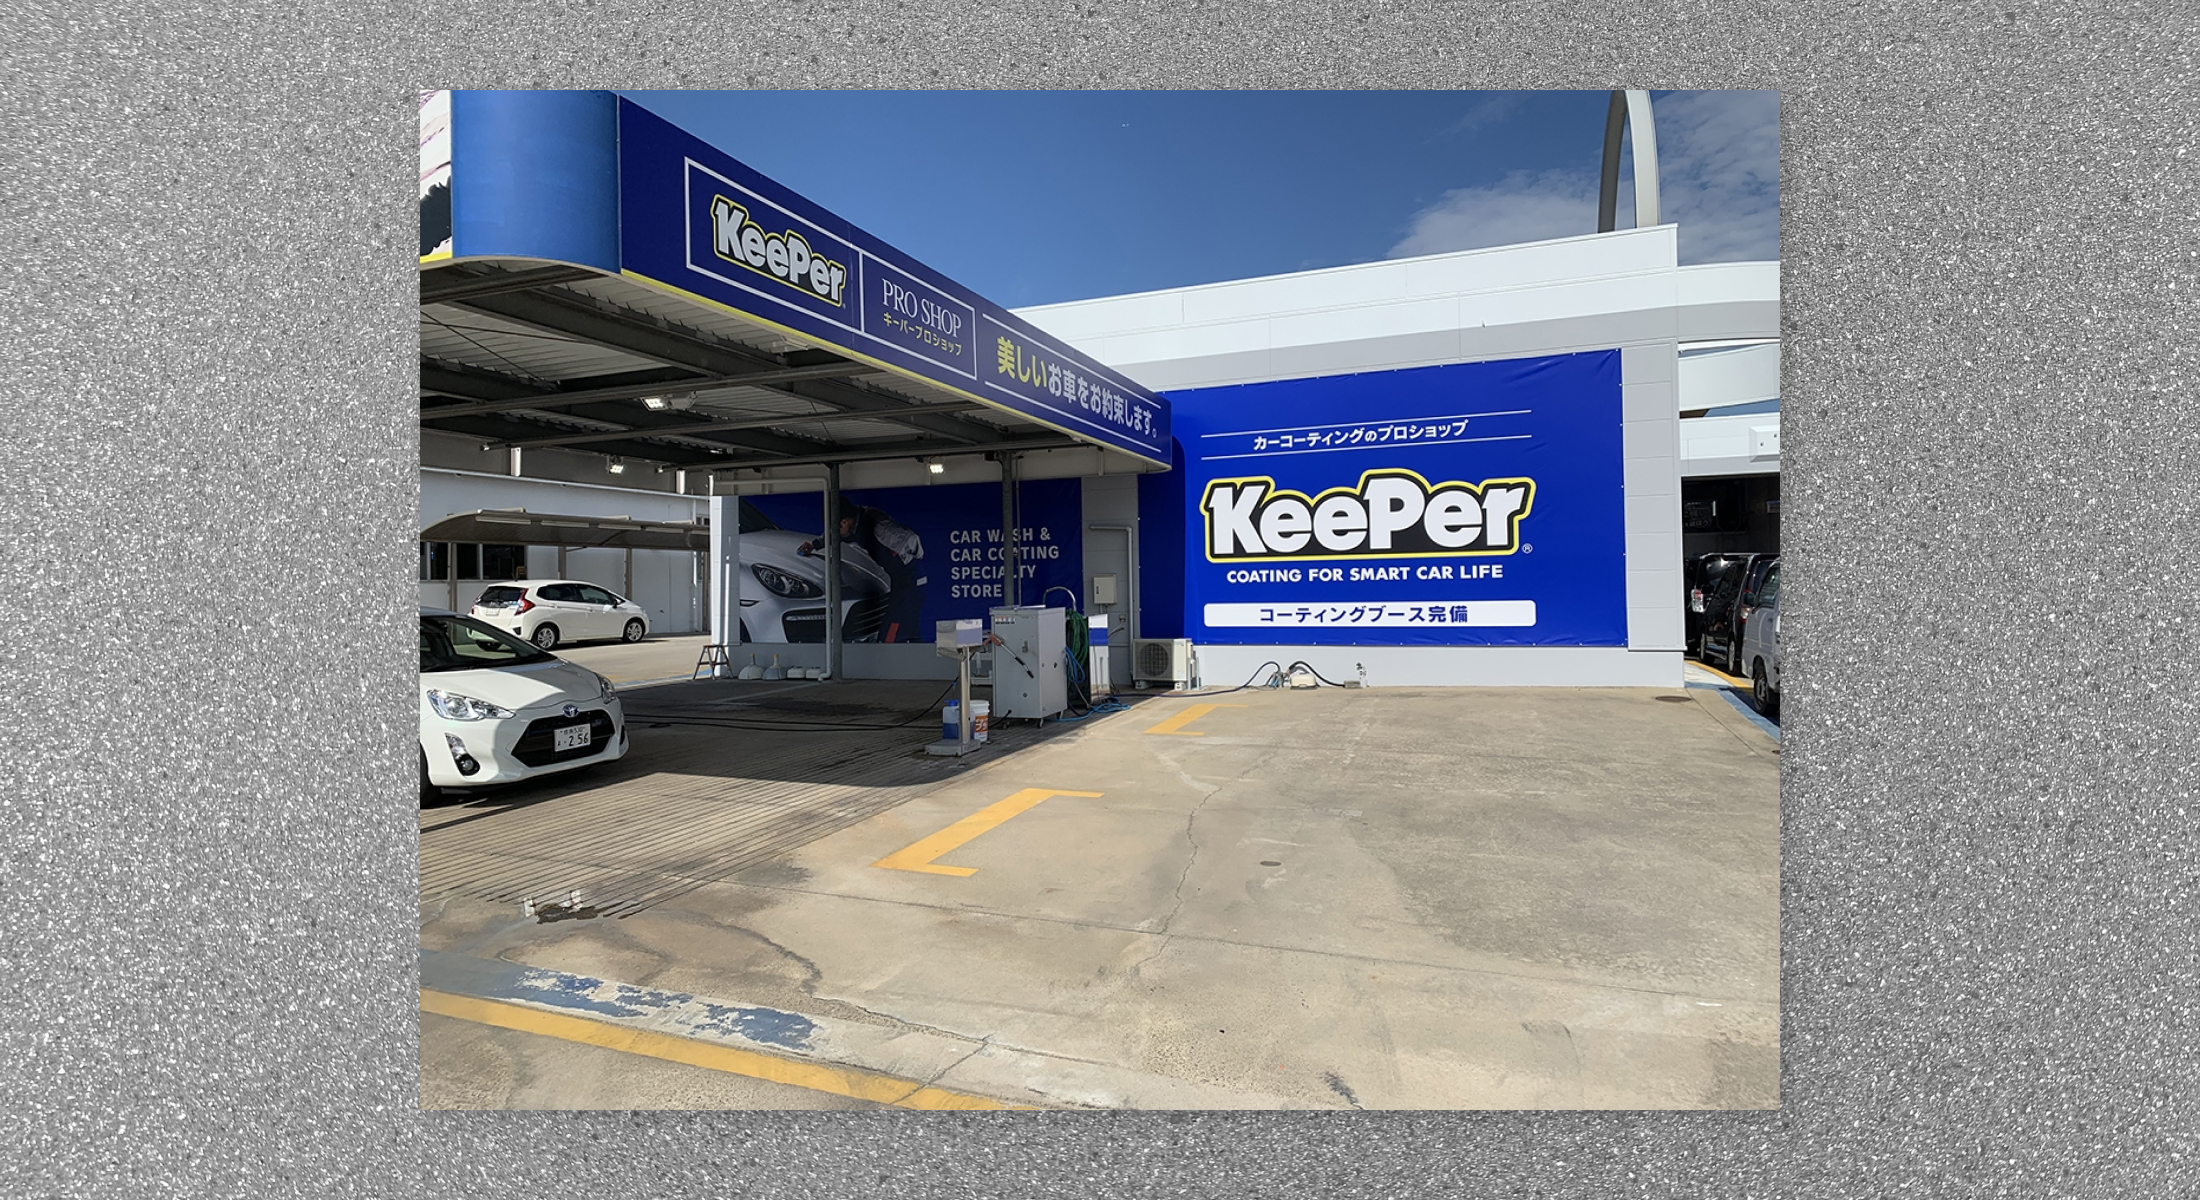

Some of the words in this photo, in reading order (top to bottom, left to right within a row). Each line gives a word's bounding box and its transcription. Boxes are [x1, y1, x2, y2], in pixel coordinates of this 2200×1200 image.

[712, 197, 845, 304] KeePer
[882, 278, 918, 318] PRO
[921, 298, 962, 338] SHOP
[883, 312, 963, 356] キーパープロショップ
[996, 336, 1158, 438] 美しいお車をお約束します。
[1253, 419, 1469, 450] カーコーティングのプロショップ
[1206, 474, 1530, 558] KeePer
[950, 530, 981, 544] CAR
[1040, 527, 1051, 540] &
[950, 548, 982, 562] CAR
[951, 565, 1036, 580] SPECIATY
[1227, 568, 1302, 583] COATING
[1308, 567, 1344, 582] FOR
[1349, 566, 1411, 581] SMART
[1416, 566, 1454, 580] CAR
[1460, 564, 1504, 579] LIFE
[951, 584, 1002, 598] STORE
[1260, 605, 1469, 624] コーティングブース完備
